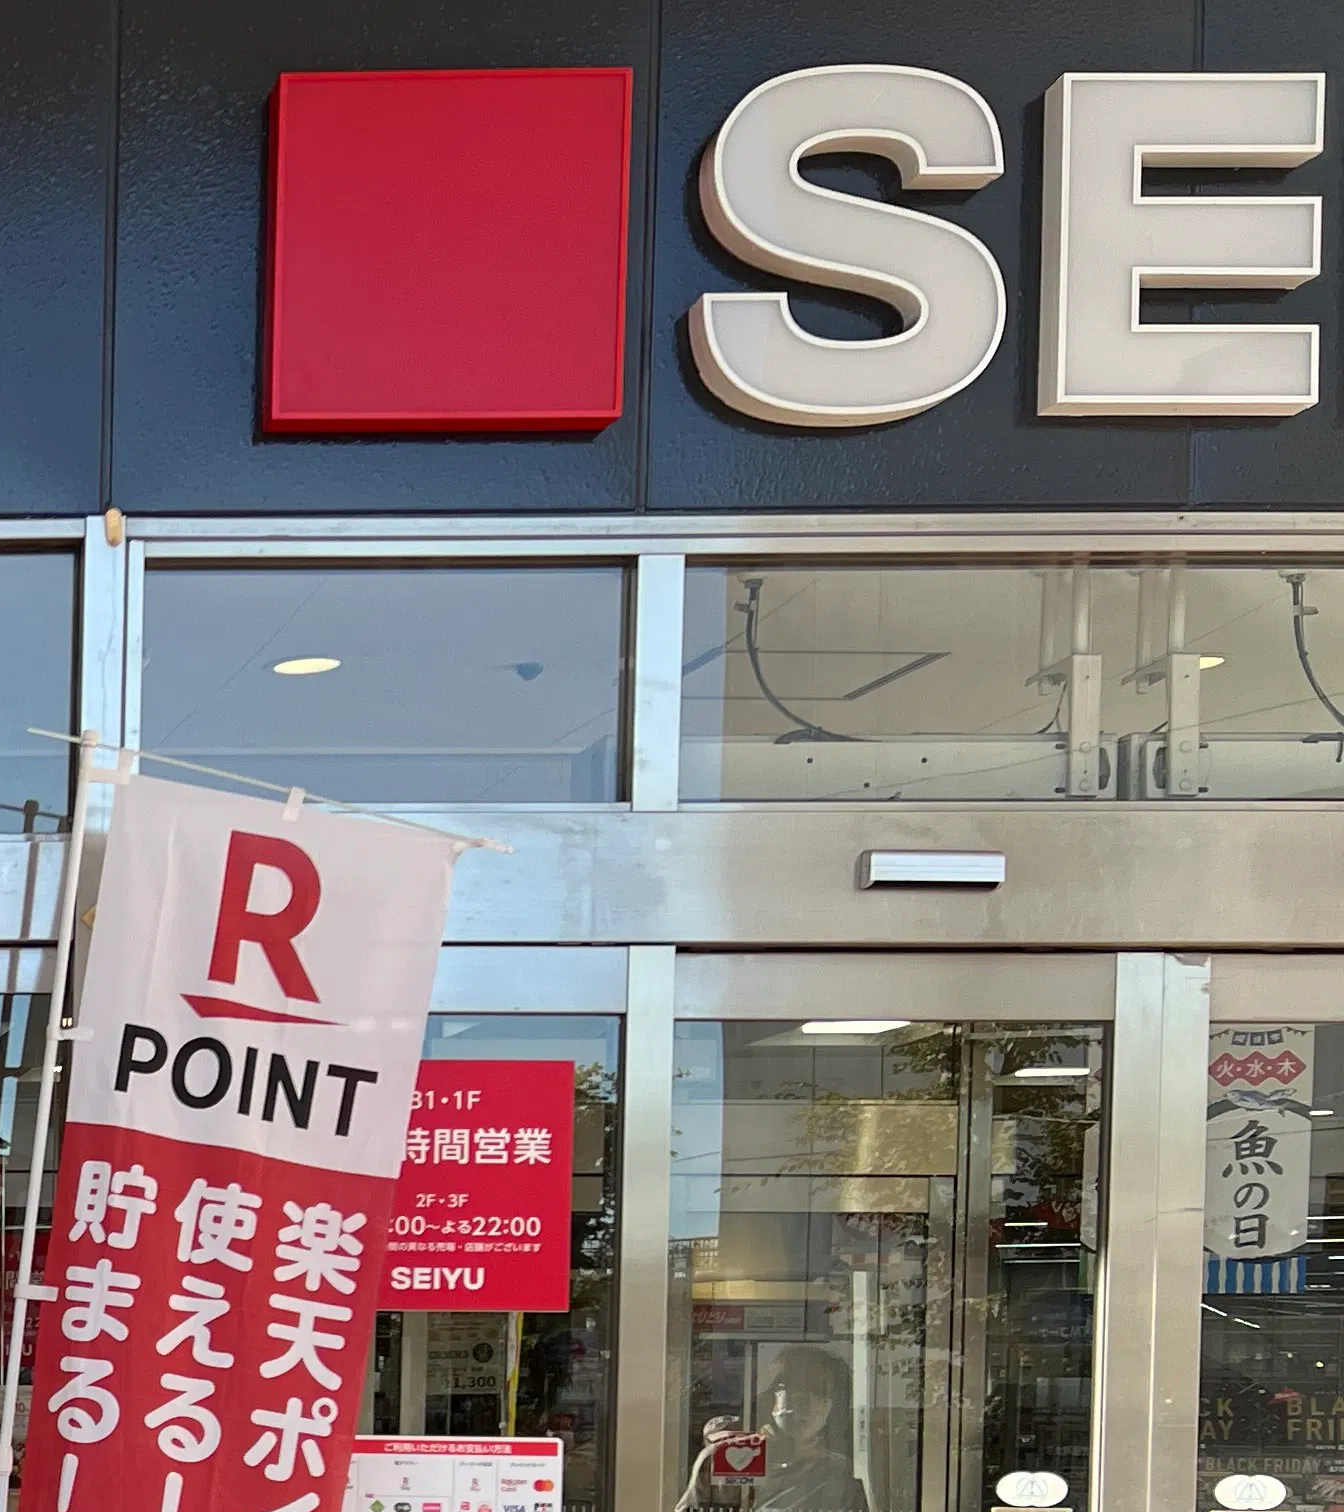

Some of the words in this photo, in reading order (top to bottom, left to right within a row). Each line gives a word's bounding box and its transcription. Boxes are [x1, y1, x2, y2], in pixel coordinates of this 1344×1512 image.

[690, 64, 1325, 427] SE
[206, 829, 322, 1004] R
[113, 1023, 379, 1138] POINT
[1216, 1058, 1297, 1079] 火・水・木
[1222, 1119, 1284, 1251] 魚の日
[390, 1266, 485, 1291] SEIYU
[502, 1504, 526, 1512] VISA
